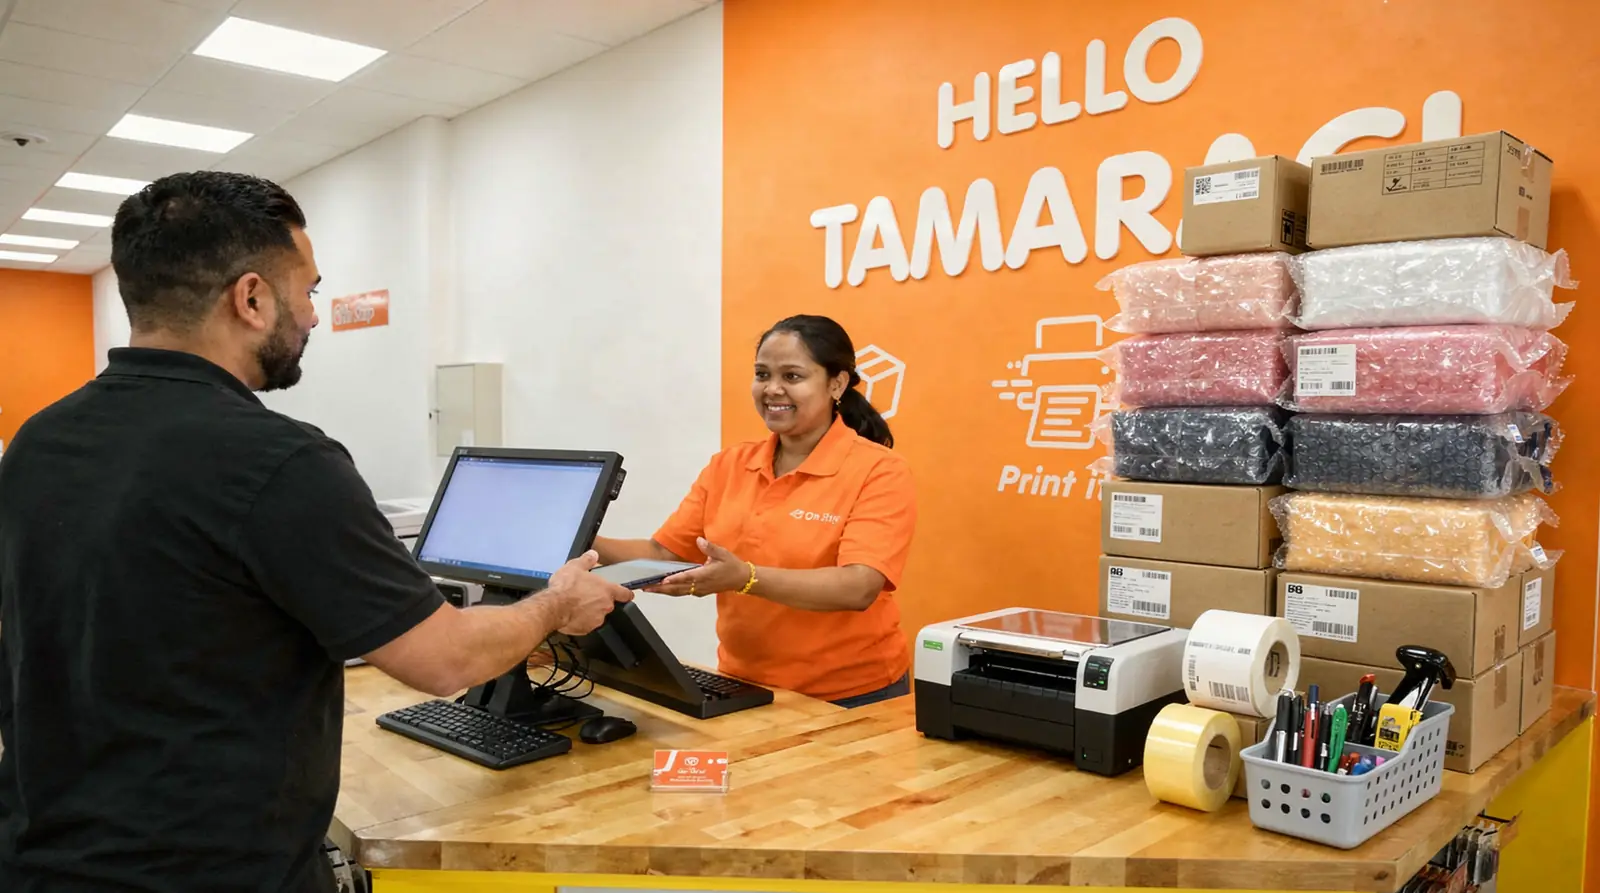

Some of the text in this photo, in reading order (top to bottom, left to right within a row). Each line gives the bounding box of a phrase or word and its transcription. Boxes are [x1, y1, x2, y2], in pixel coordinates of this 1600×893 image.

[938, 17, 1203, 149] HELLO
[810, 89, 1462, 289] TAMAR
[998, 464, 1077, 498] Print
